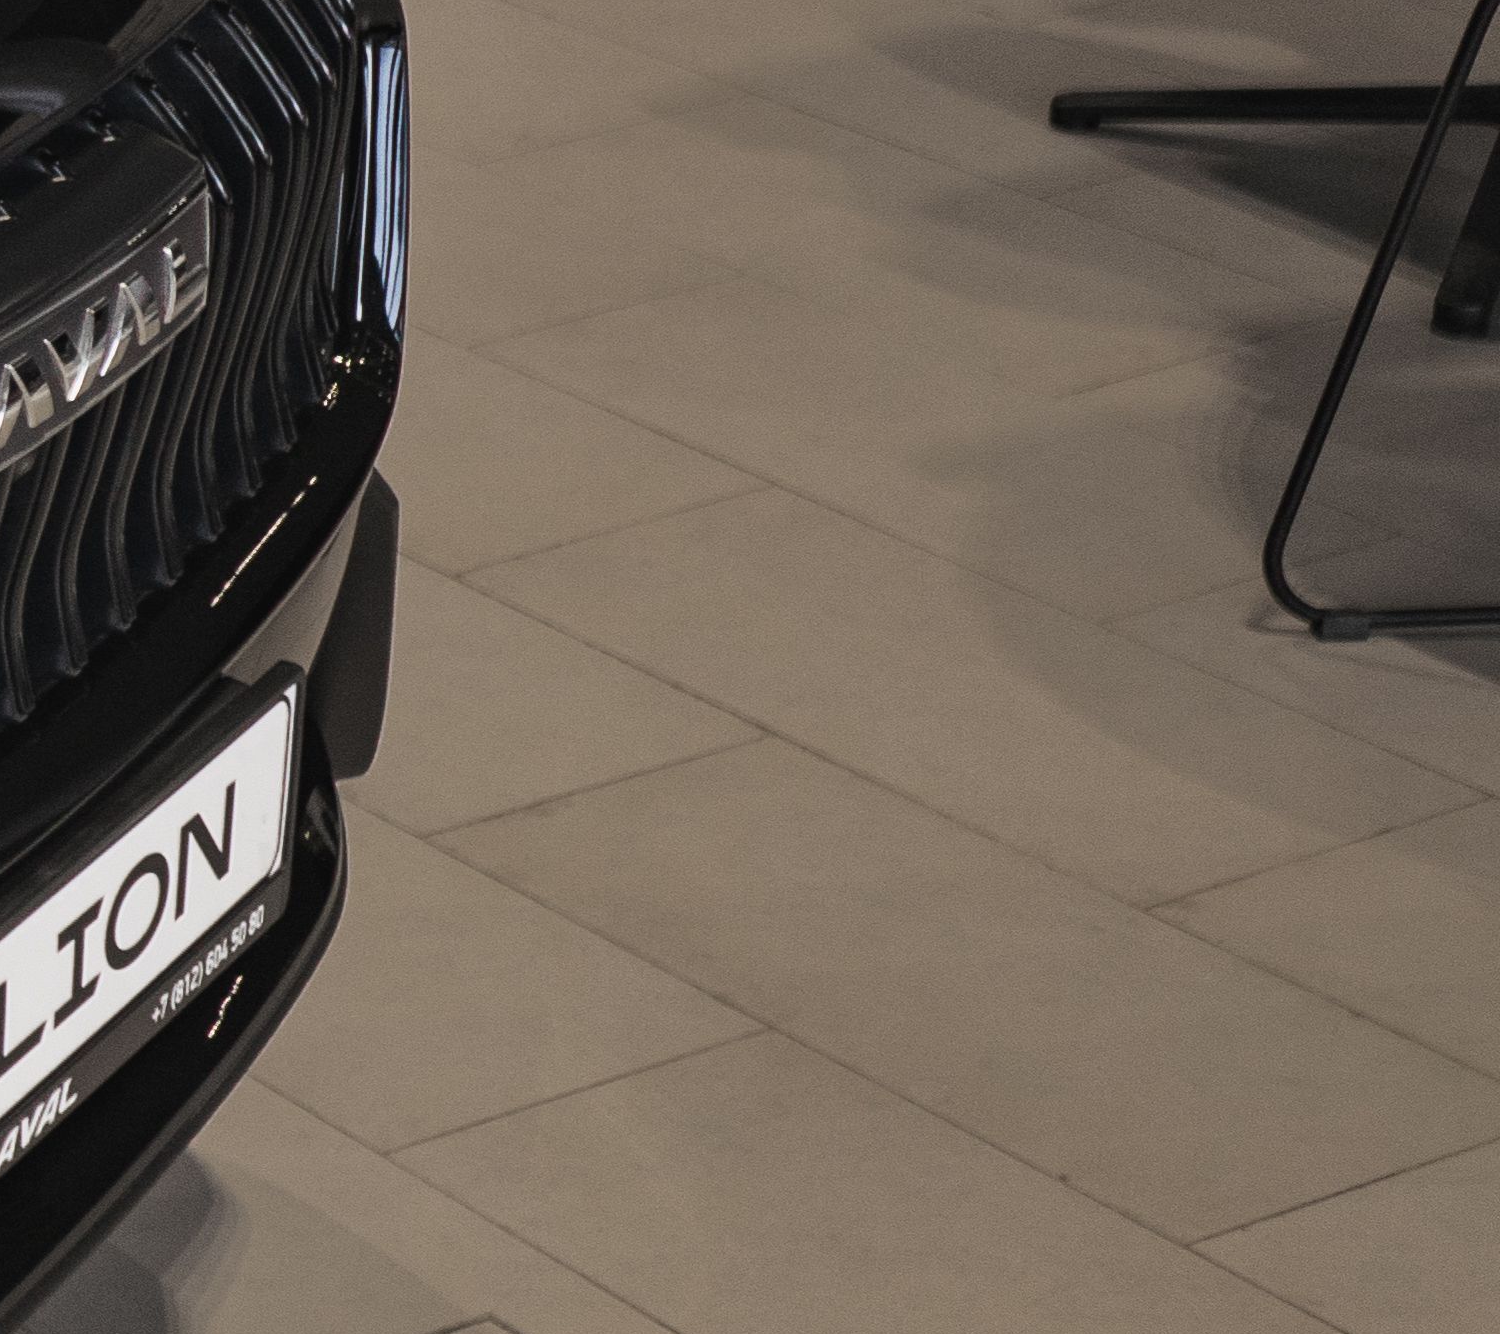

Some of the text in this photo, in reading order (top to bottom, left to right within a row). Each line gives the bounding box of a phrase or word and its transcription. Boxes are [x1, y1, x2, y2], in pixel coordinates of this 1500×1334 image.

[151, 992, 169, 1023] +7
[171, 960, 203, 1010] (812)
[248, 904, 264, 936] 80
